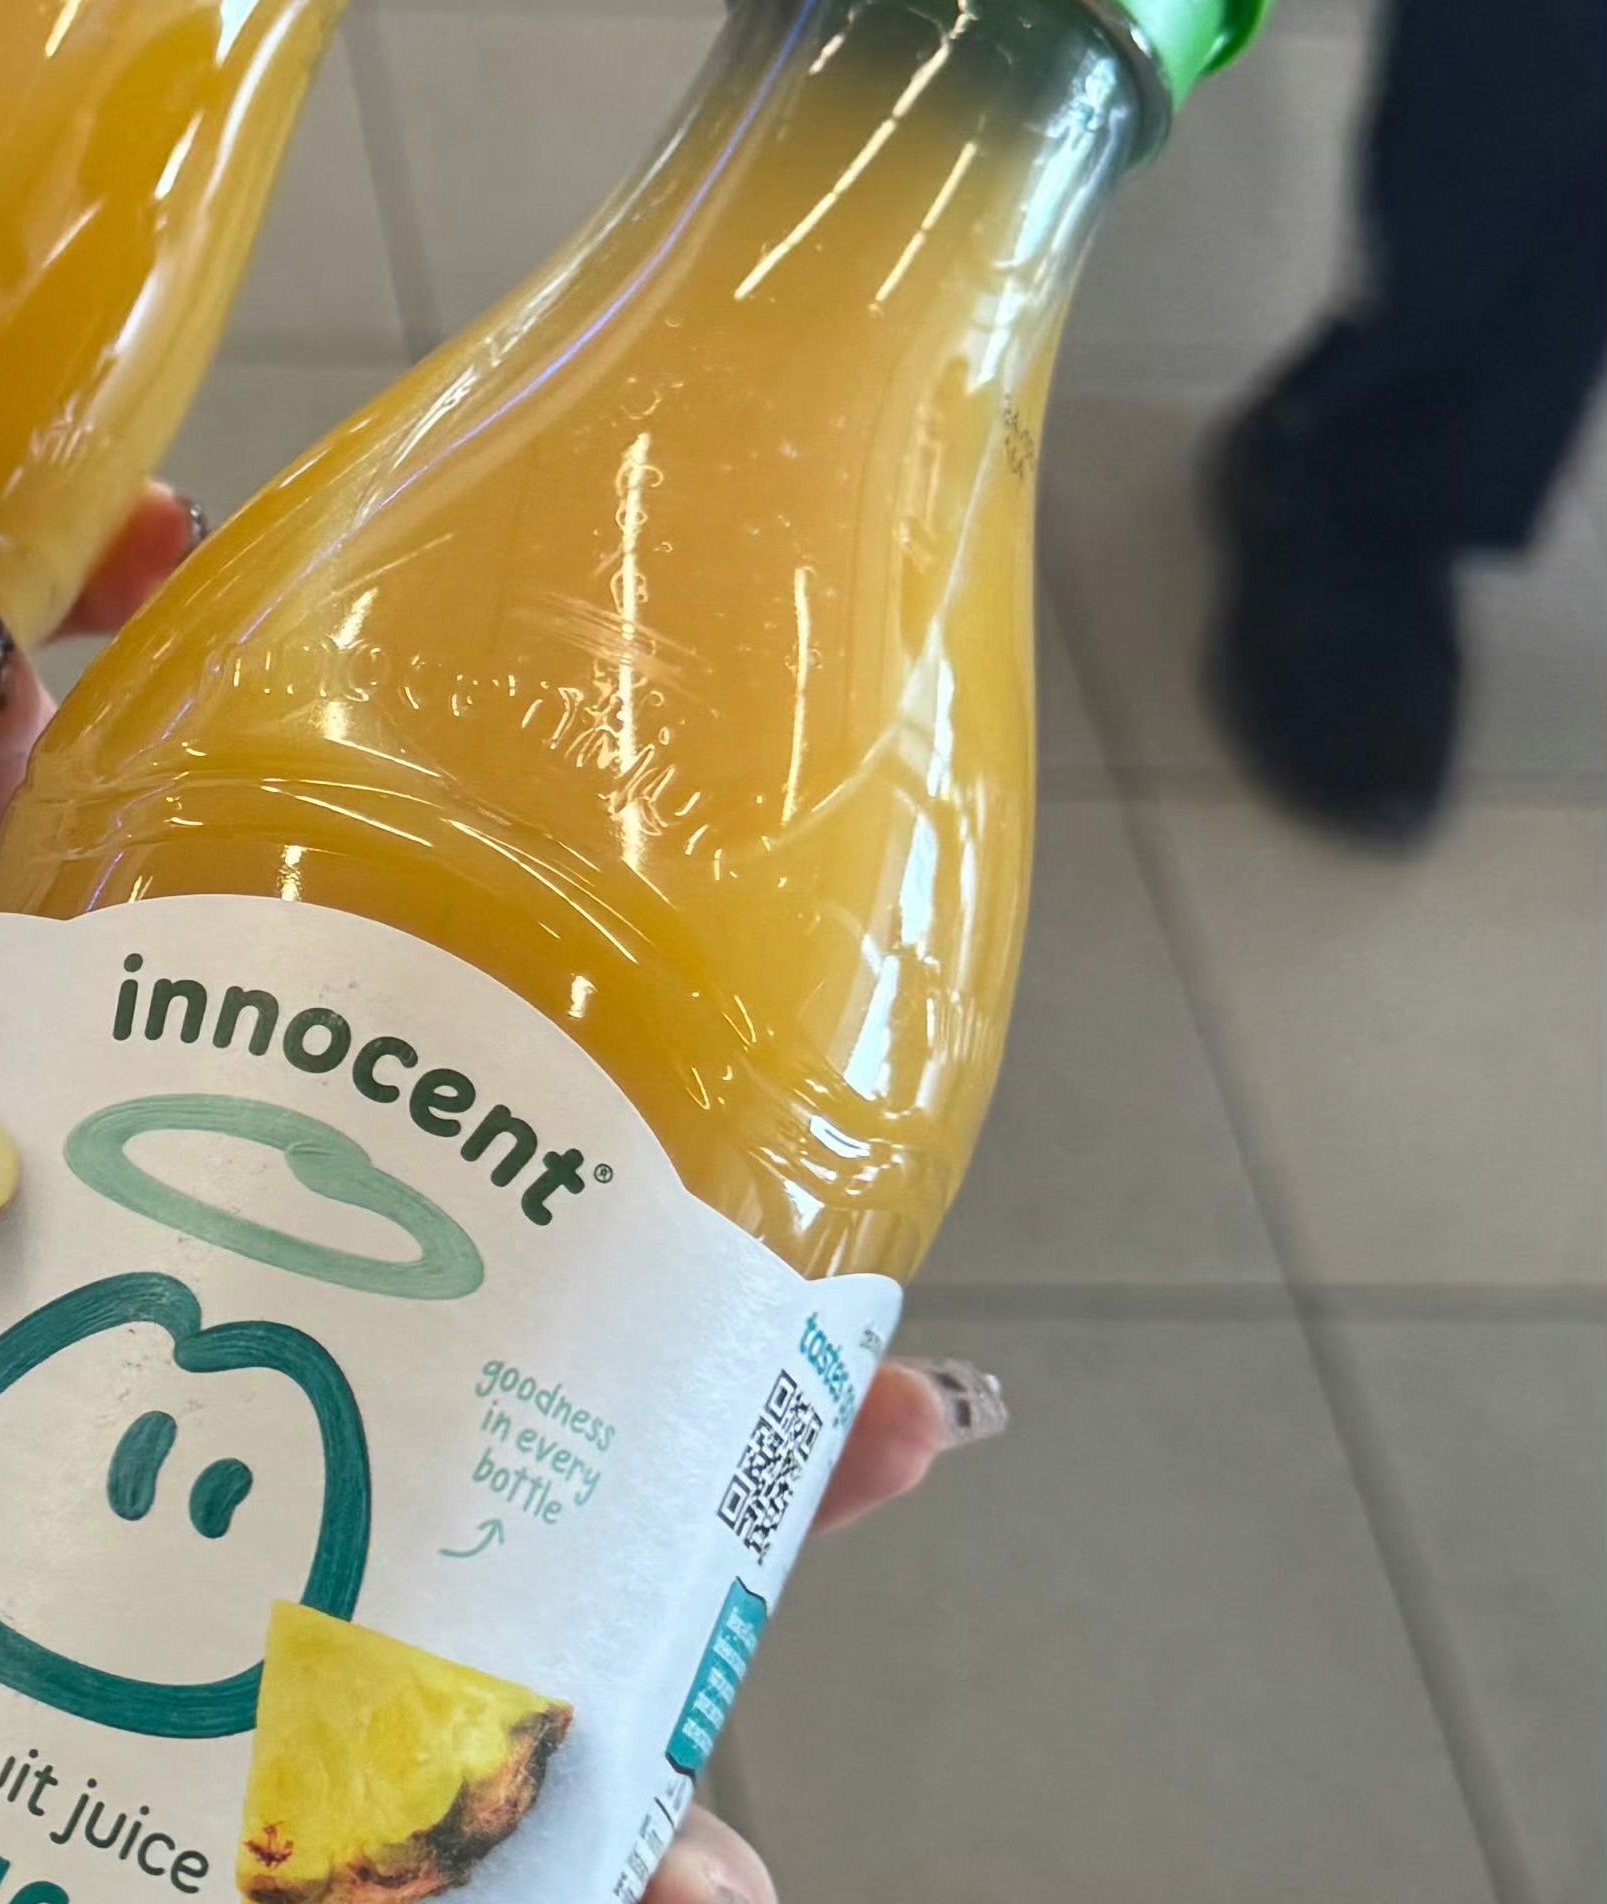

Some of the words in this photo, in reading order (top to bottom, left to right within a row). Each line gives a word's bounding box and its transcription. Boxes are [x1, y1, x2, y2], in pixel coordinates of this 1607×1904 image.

[474, 1359, 616, 1452] goodness
[471, 1451, 563, 1525] bottle
[481, 1408, 514, 1443] in
[515, 1428, 601, 1506] every
[49, 1778, 210, 1895] juice
